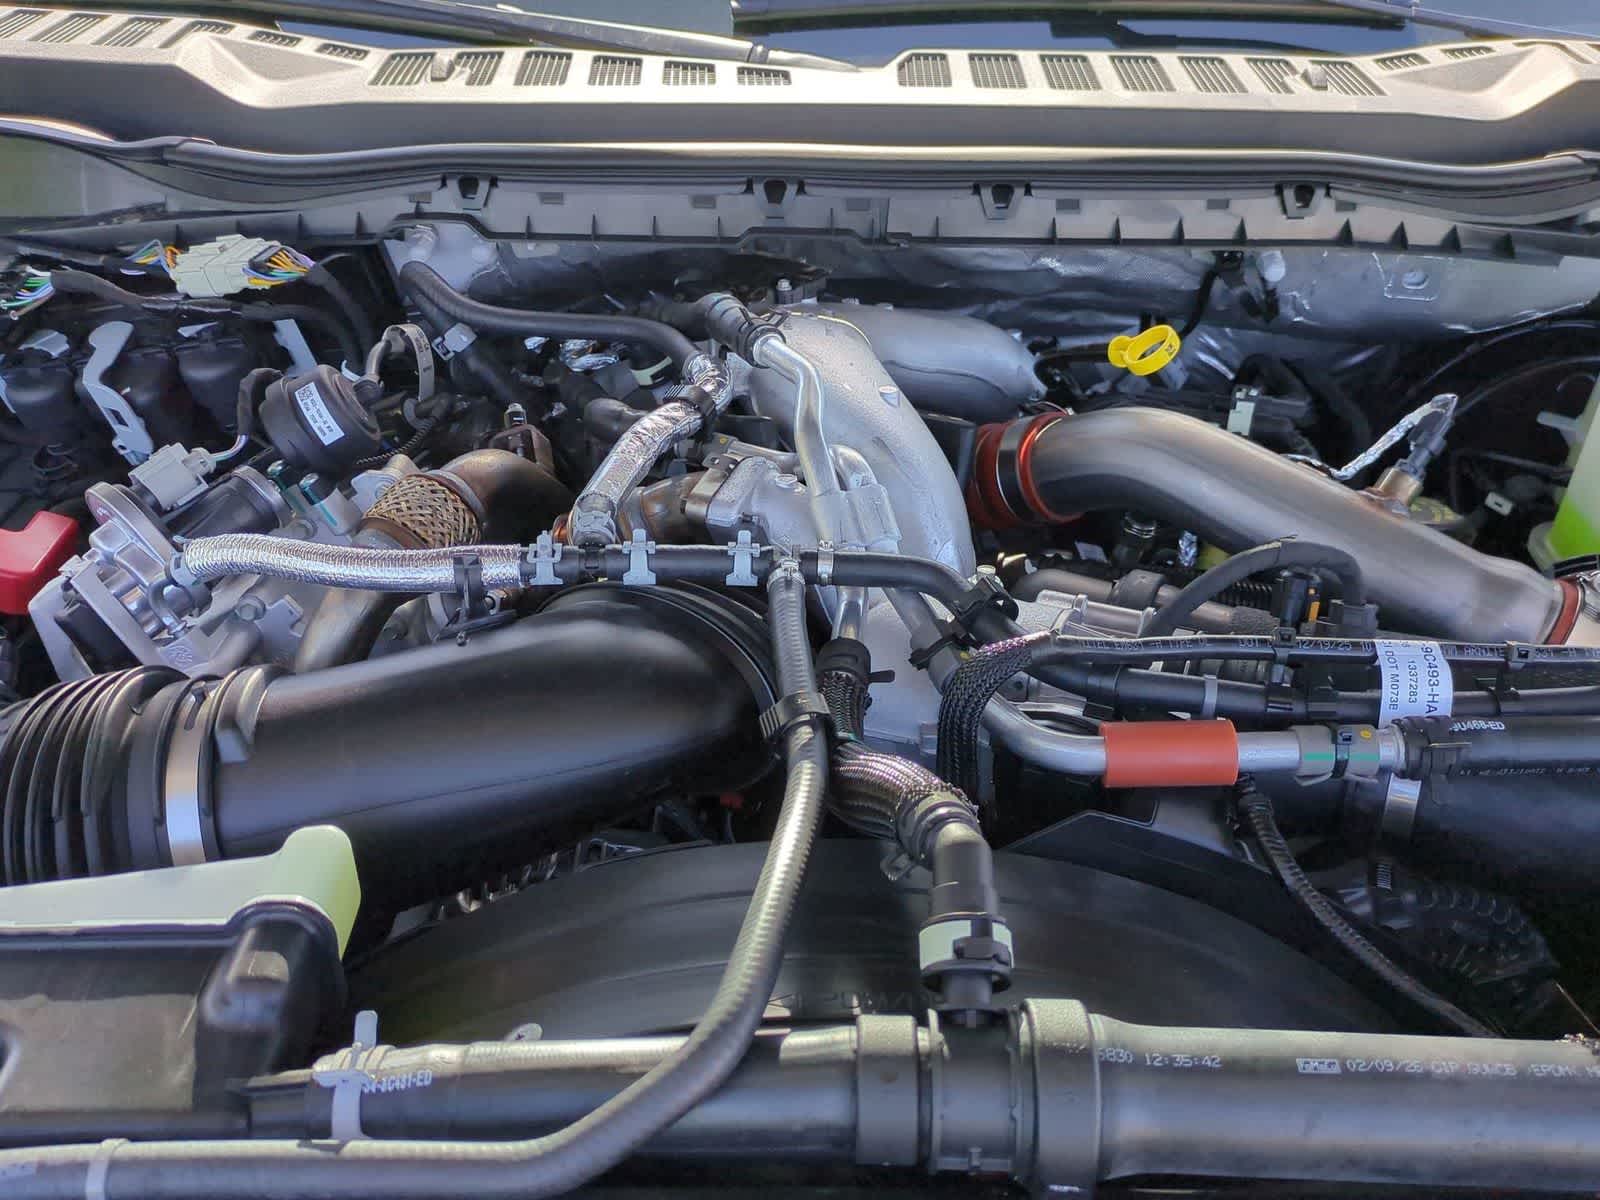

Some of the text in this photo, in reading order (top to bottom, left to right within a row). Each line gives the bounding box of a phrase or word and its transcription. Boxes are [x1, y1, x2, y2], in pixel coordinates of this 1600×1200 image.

[1385, 651, 1399, 671] DOT
[1407, 660, 1418, 704] 1337283
[1144, 1053, 1222, 1068] 12:35:42
